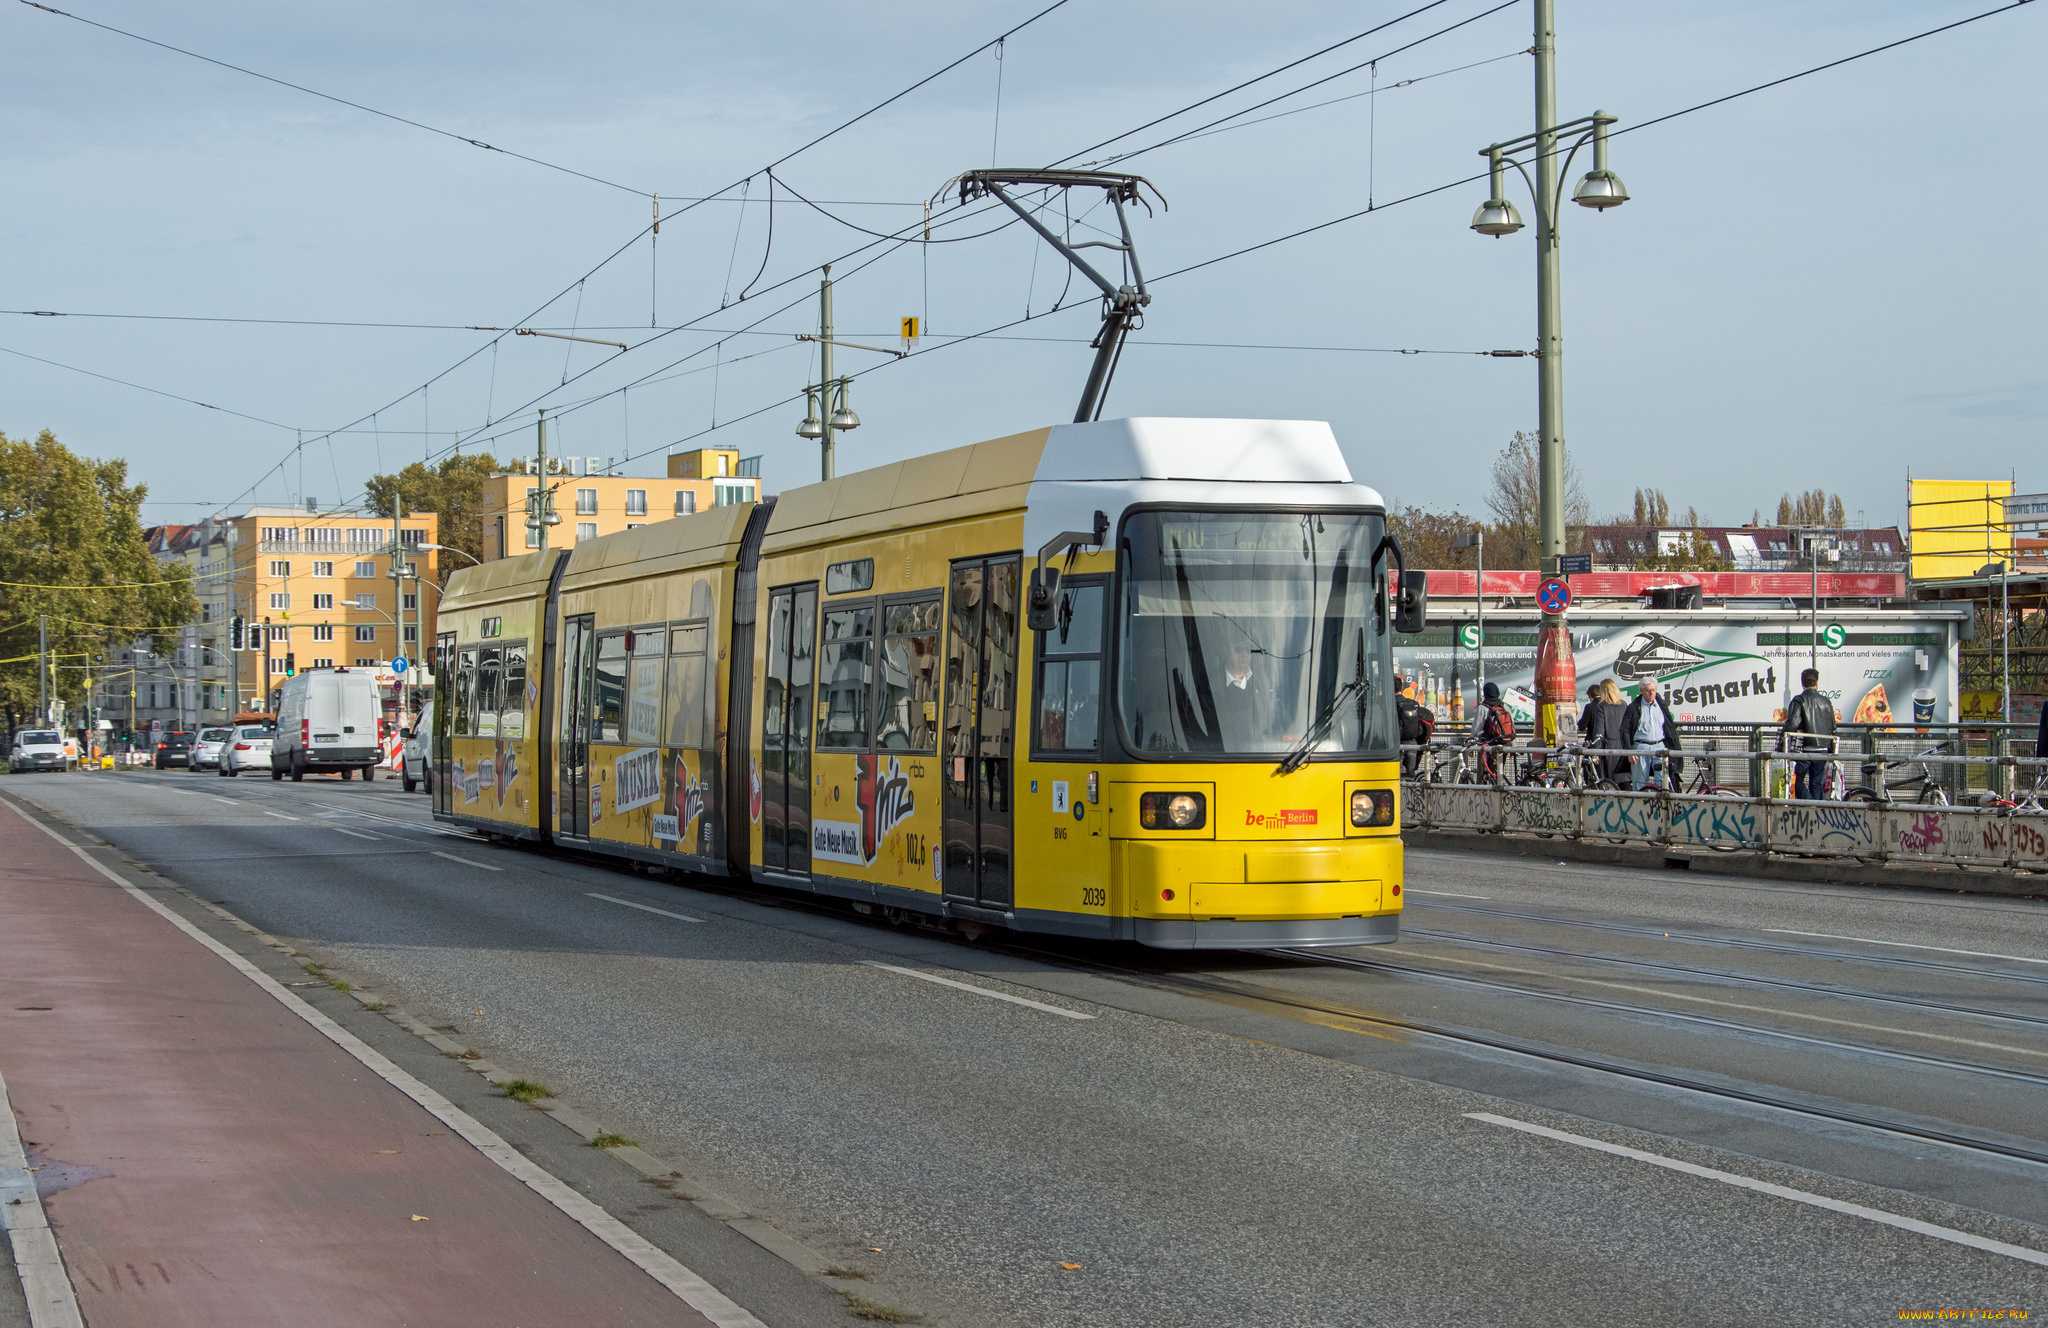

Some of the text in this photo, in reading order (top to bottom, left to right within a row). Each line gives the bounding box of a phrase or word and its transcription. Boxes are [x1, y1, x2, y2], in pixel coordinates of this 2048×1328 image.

[904, 318, 913, 337] 1
[525, 455, 618, 476] HOTEL
[1392, 635, 1454, 645] AHRSCHEINE
[1492, 635, 1528, 645] TICKETS
[1579, 632, 1609, 649] Ihr
[1827, 625, 1843, 648] S
[1872, 635, 1937, 645] TICKETS & MORE
[1517, 651, 1533, 659] und
[1857, 650, 1869, 658] und
[1871, 650, 1891, 658] vieles
[1863, 669, 1893, 679] PIZZA
[617, 749, 659, 806] MUSIK
[909, 760, 924, 779] rbb
[1245, 809, 1315, 826] be Berlin
[814, 826, 826, 852] Gute
[827, 827, 840, 853] Neue
[1054, 827, 1067, 840] BVG
[906, 832, 926, 871] 102,6
[1082, 887, 1106, 907] 2039
